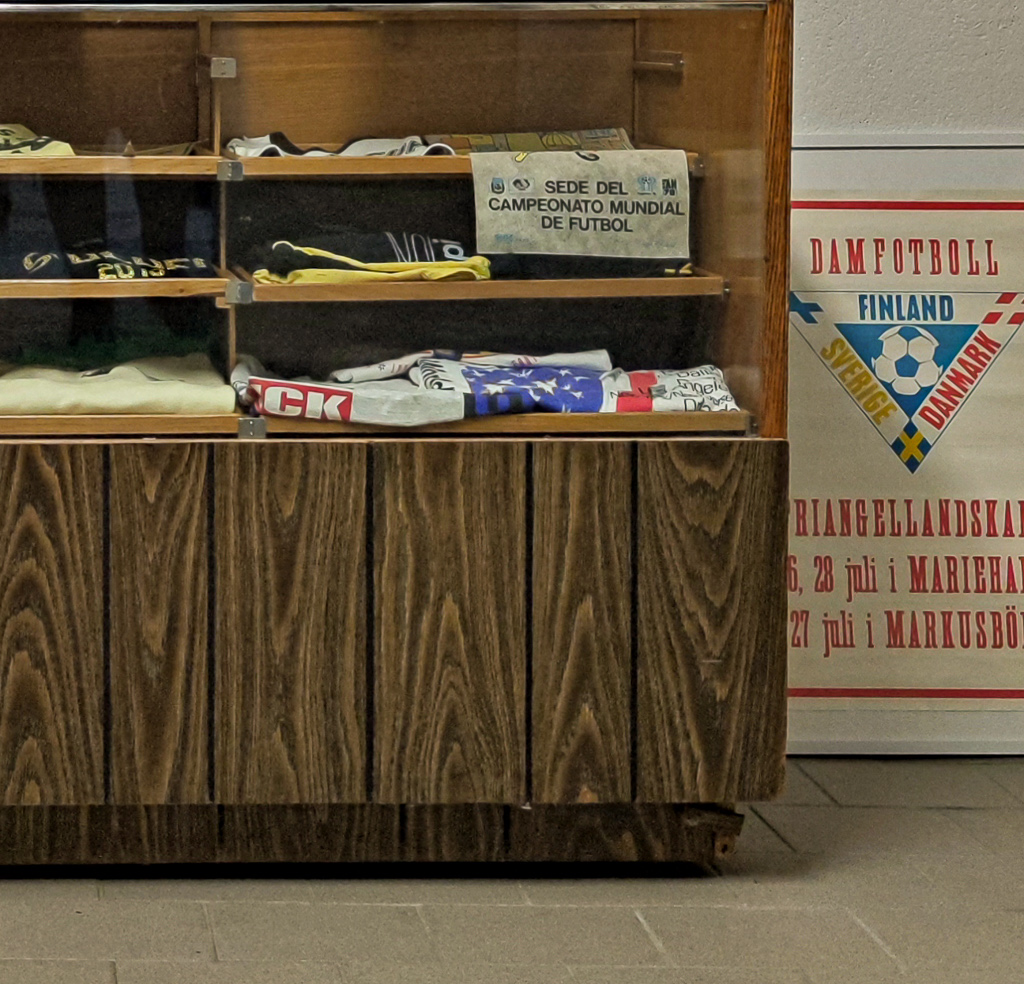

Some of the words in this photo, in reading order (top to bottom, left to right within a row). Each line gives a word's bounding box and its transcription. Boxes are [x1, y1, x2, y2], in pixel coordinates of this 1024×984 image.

[545, 180, 589, 194] SEDE
[597, 181, 628, 195] DEL
[489, 198, 604, 214] CAMPEONATO
[610, 200, 685, 215] MUNDIAL
[541, 216, 563, 229] DE
[569, 218, 633, 232] FUTBOL
[810, 238, 999, 276] DAMFOTBOLL
[858, 294, 954, 321] FINLAND
[820, 337, 898, 426] SVERIGE
[918, 330, 1001, 431] DANMARK
[250, 384, 347, 421] CK
[814, 555, 834, 593] 28
[845, 556, 878, 602] juli
[889, 558, 897, 593] i
[790, 610, 809, 648] 27
[822, 610, 855, 658] juli
[866, 613, 874, 648] i
[884, 605, 1024, 649] MARKUSBÖ
